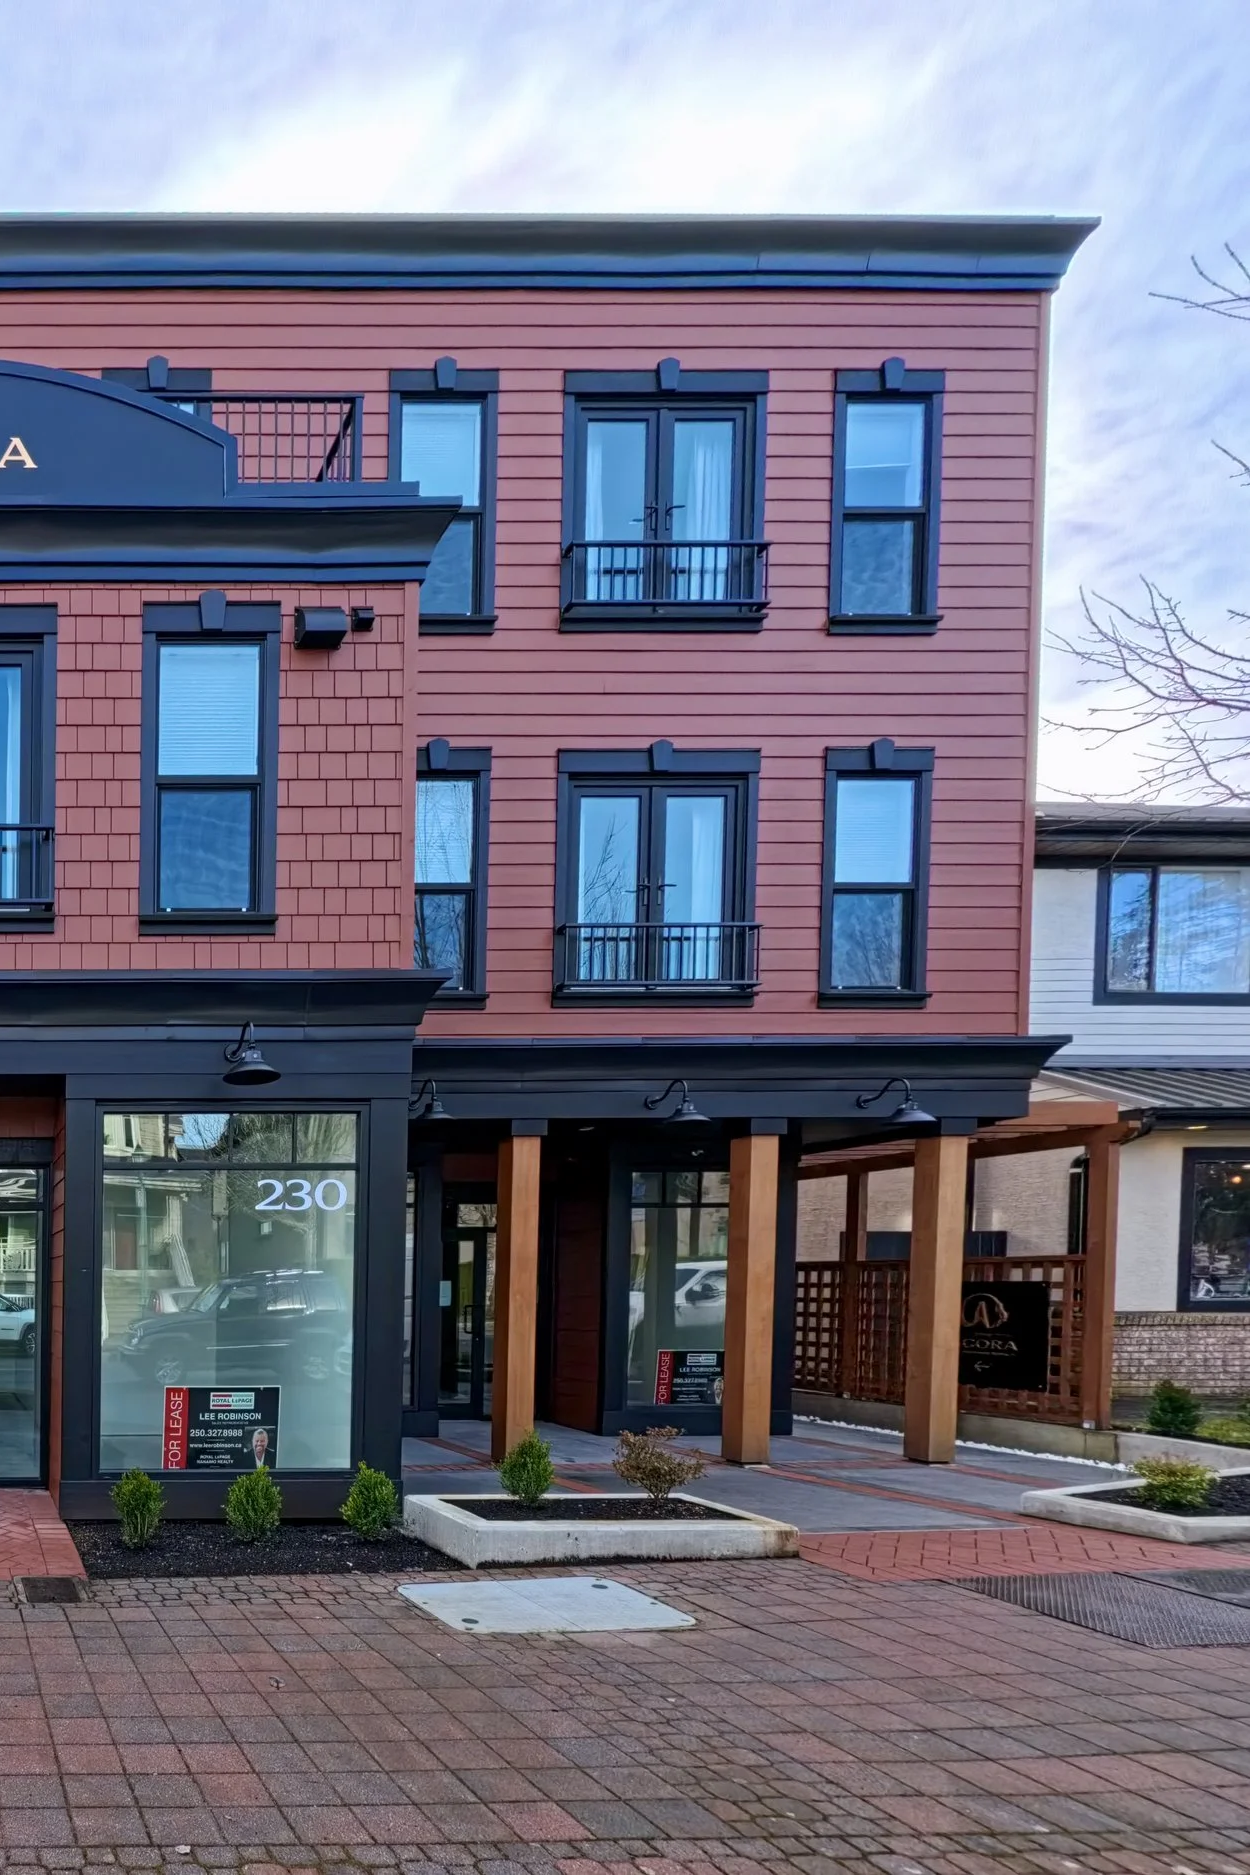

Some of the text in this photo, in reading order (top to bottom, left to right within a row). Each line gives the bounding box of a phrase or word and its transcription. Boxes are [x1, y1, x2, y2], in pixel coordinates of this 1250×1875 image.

[255, 1179, 348, 1210] 230
[962, 1339, 1018, 1351] GORA
[658, 1353, 671, 1405] FOR LEASE
[199, 1412, 262, 1420] LEE ROBINSON
[168, 1391, 183, 1469] FOR LEASE
[189, 1429, 243, 1437] 250.327.8988
